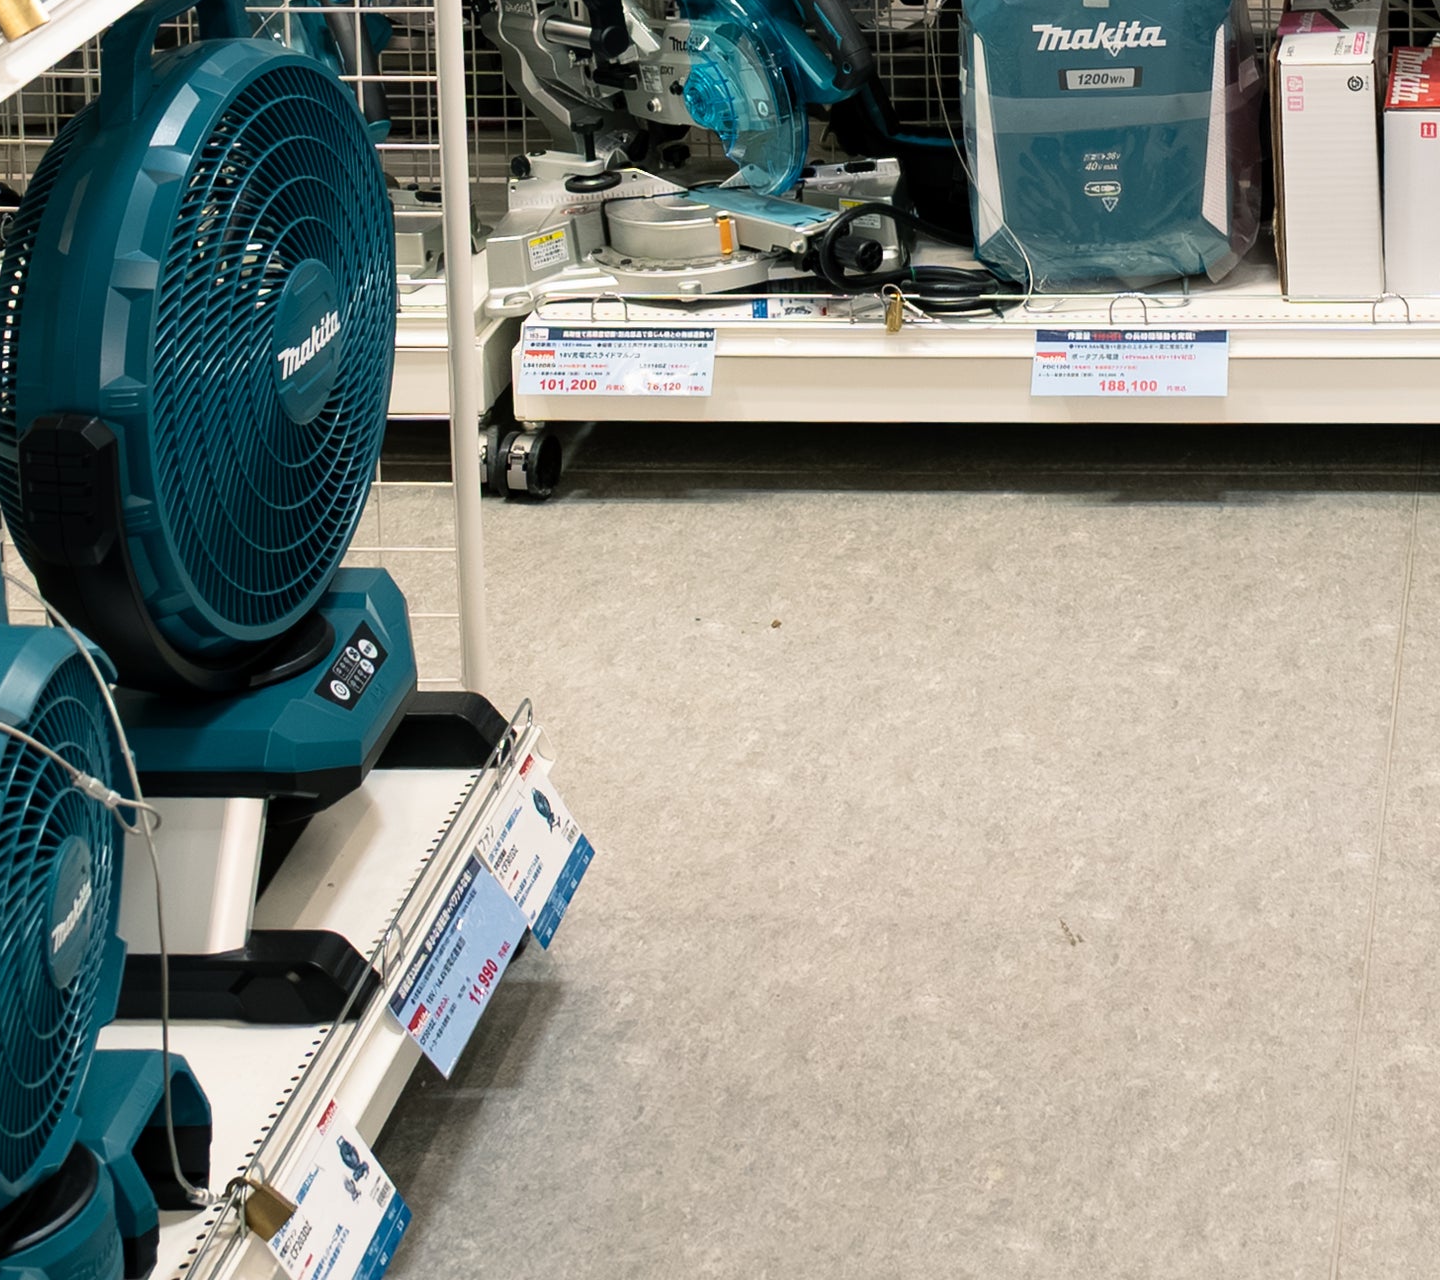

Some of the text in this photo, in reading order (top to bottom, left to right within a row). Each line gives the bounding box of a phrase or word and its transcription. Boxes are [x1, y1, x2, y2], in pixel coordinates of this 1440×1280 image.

[1031, 22, 1168, 53] Makita
[278, 307, 344, 382] Makita
[539, 379, 597, 392] 101,200
[1099, 381, 1157, 392] 188,100
